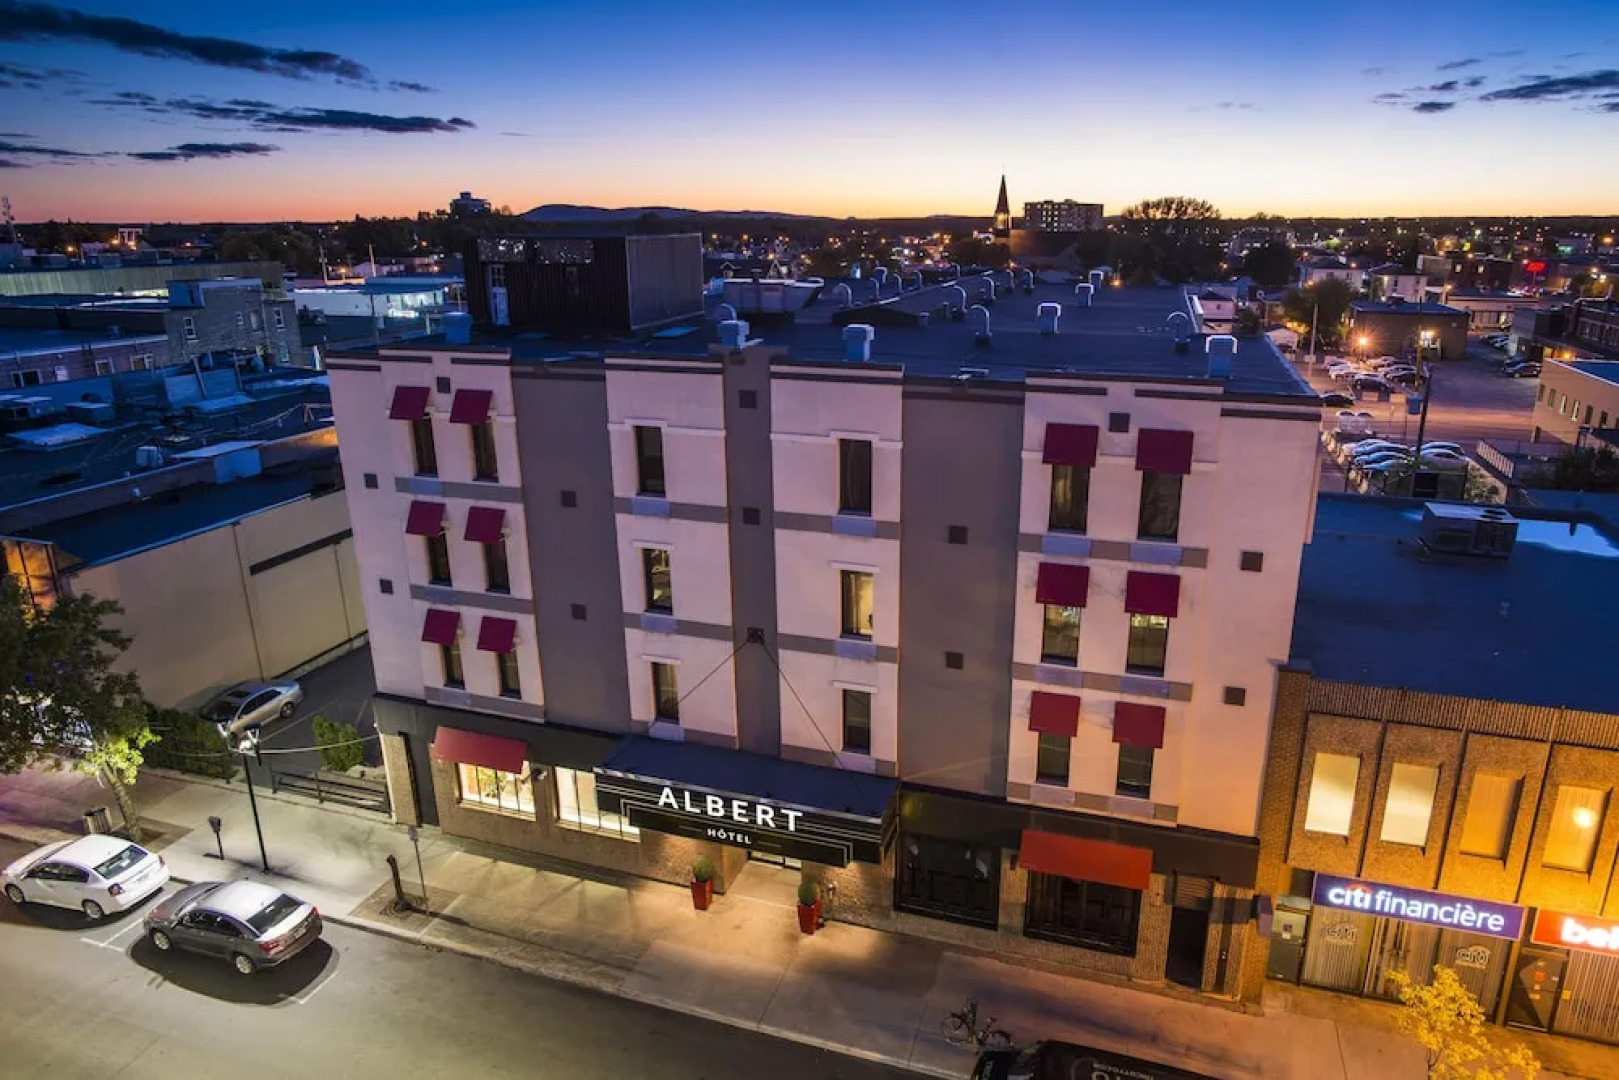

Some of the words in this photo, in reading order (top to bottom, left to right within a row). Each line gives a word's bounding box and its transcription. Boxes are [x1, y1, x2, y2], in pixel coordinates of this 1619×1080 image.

[658, 786, 803, 832] ALBERT
[707, 828, 752, 845] HÔTEL
[1327, 886, 1374, 909] citi
[1374, 890, 1505, 932] financière
